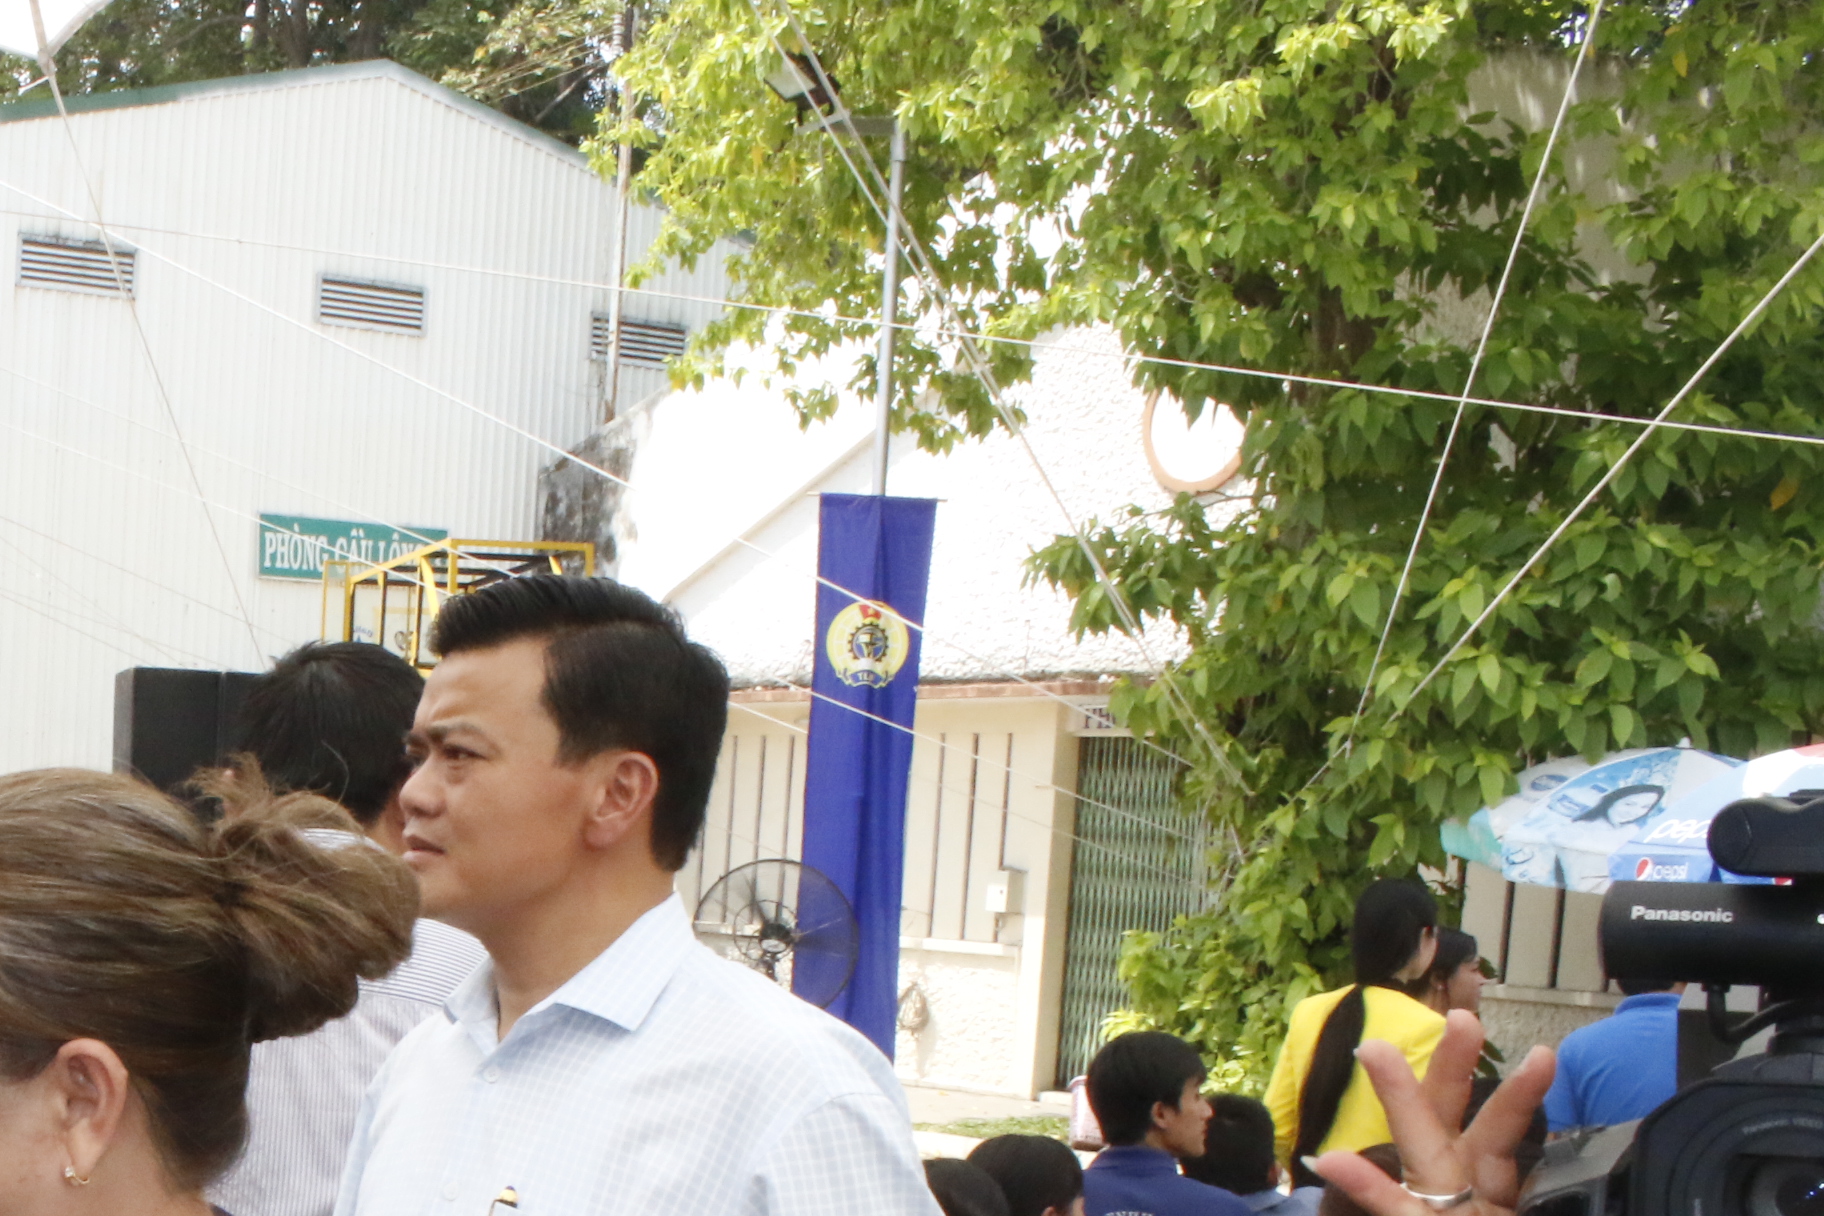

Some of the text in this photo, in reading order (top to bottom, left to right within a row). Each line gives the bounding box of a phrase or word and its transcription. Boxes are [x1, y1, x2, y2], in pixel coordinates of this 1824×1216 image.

[263, 523, 329, 578] PHÒNG
[1642, 818, 1710, 844] pep
[1652, 861, 1689, 881] pepsi
[1630, 904, 1733, 923] Panasonic
